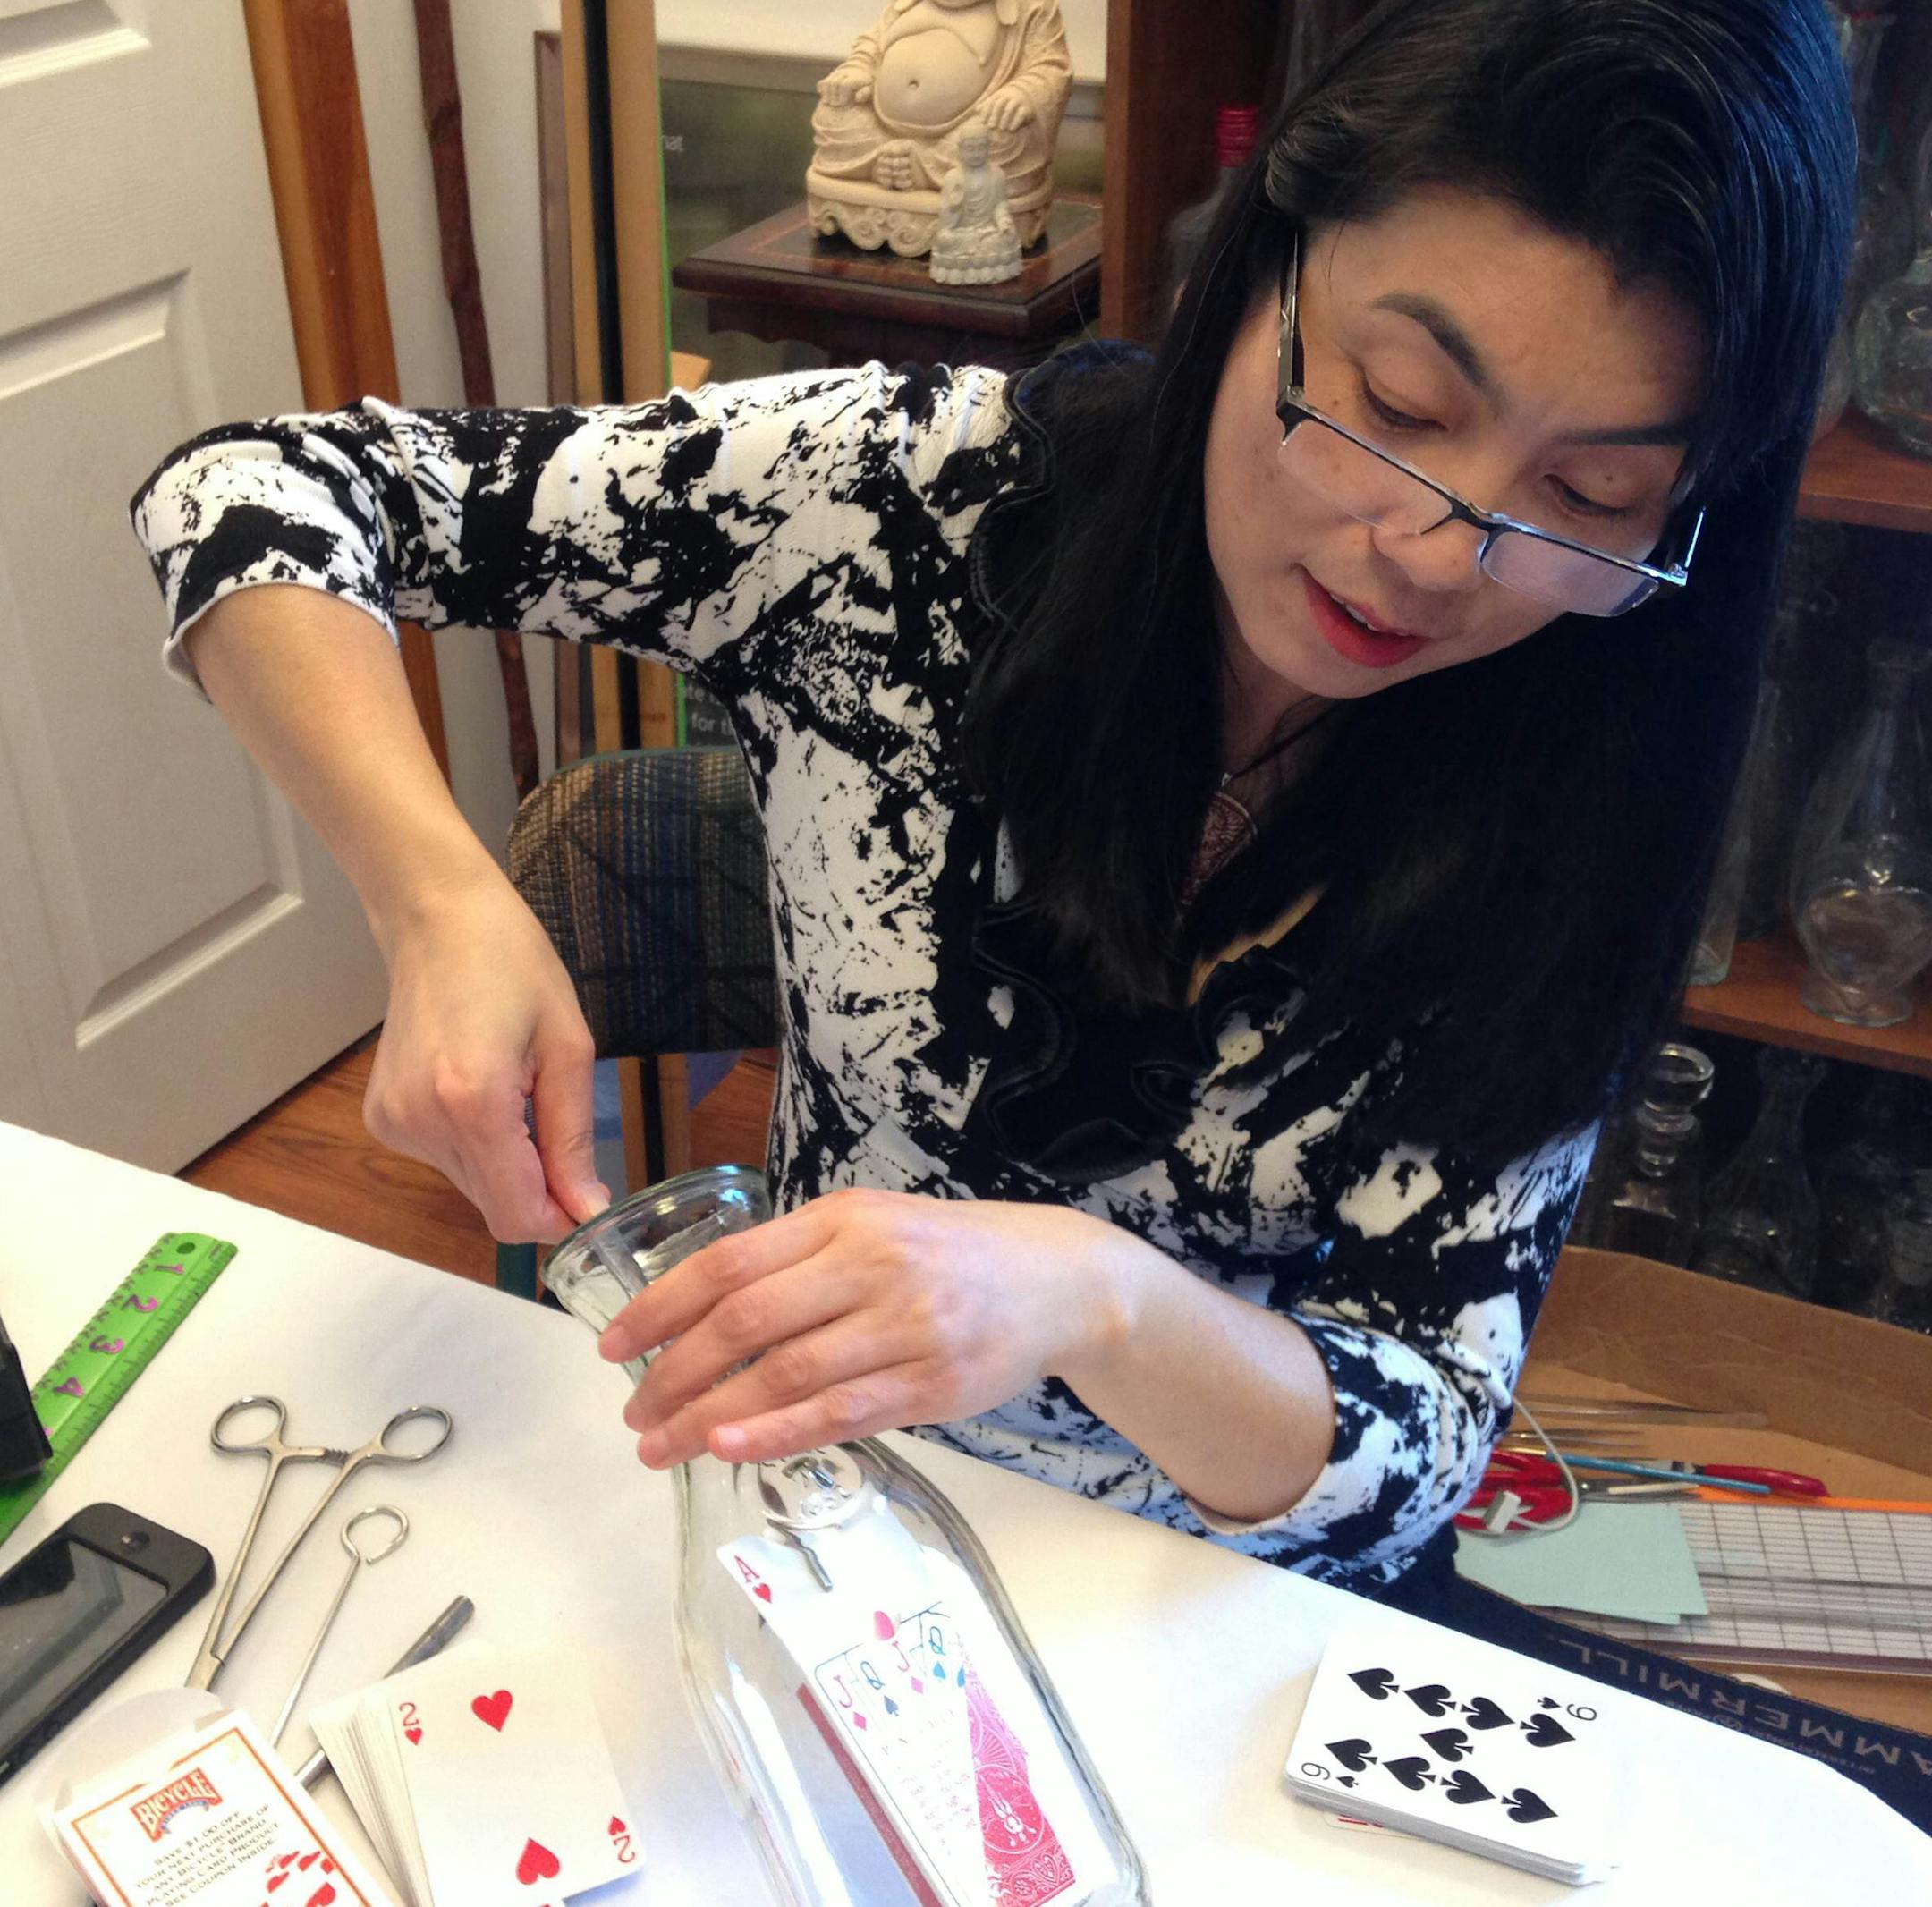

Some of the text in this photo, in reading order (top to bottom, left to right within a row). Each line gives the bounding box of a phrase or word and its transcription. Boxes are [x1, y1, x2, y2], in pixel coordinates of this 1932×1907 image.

[122, 1294, 158, 1312] 2
[89, 1335, 124, 1354] 3
[55, 1377, 84, 1397] 4
[734, 1555, 760, 1583] A
[398, 1702, 419, 1727] 2
[137, 1772, 220, 1833] BICYCLE
[613, 1835, 636, 1864] 2
